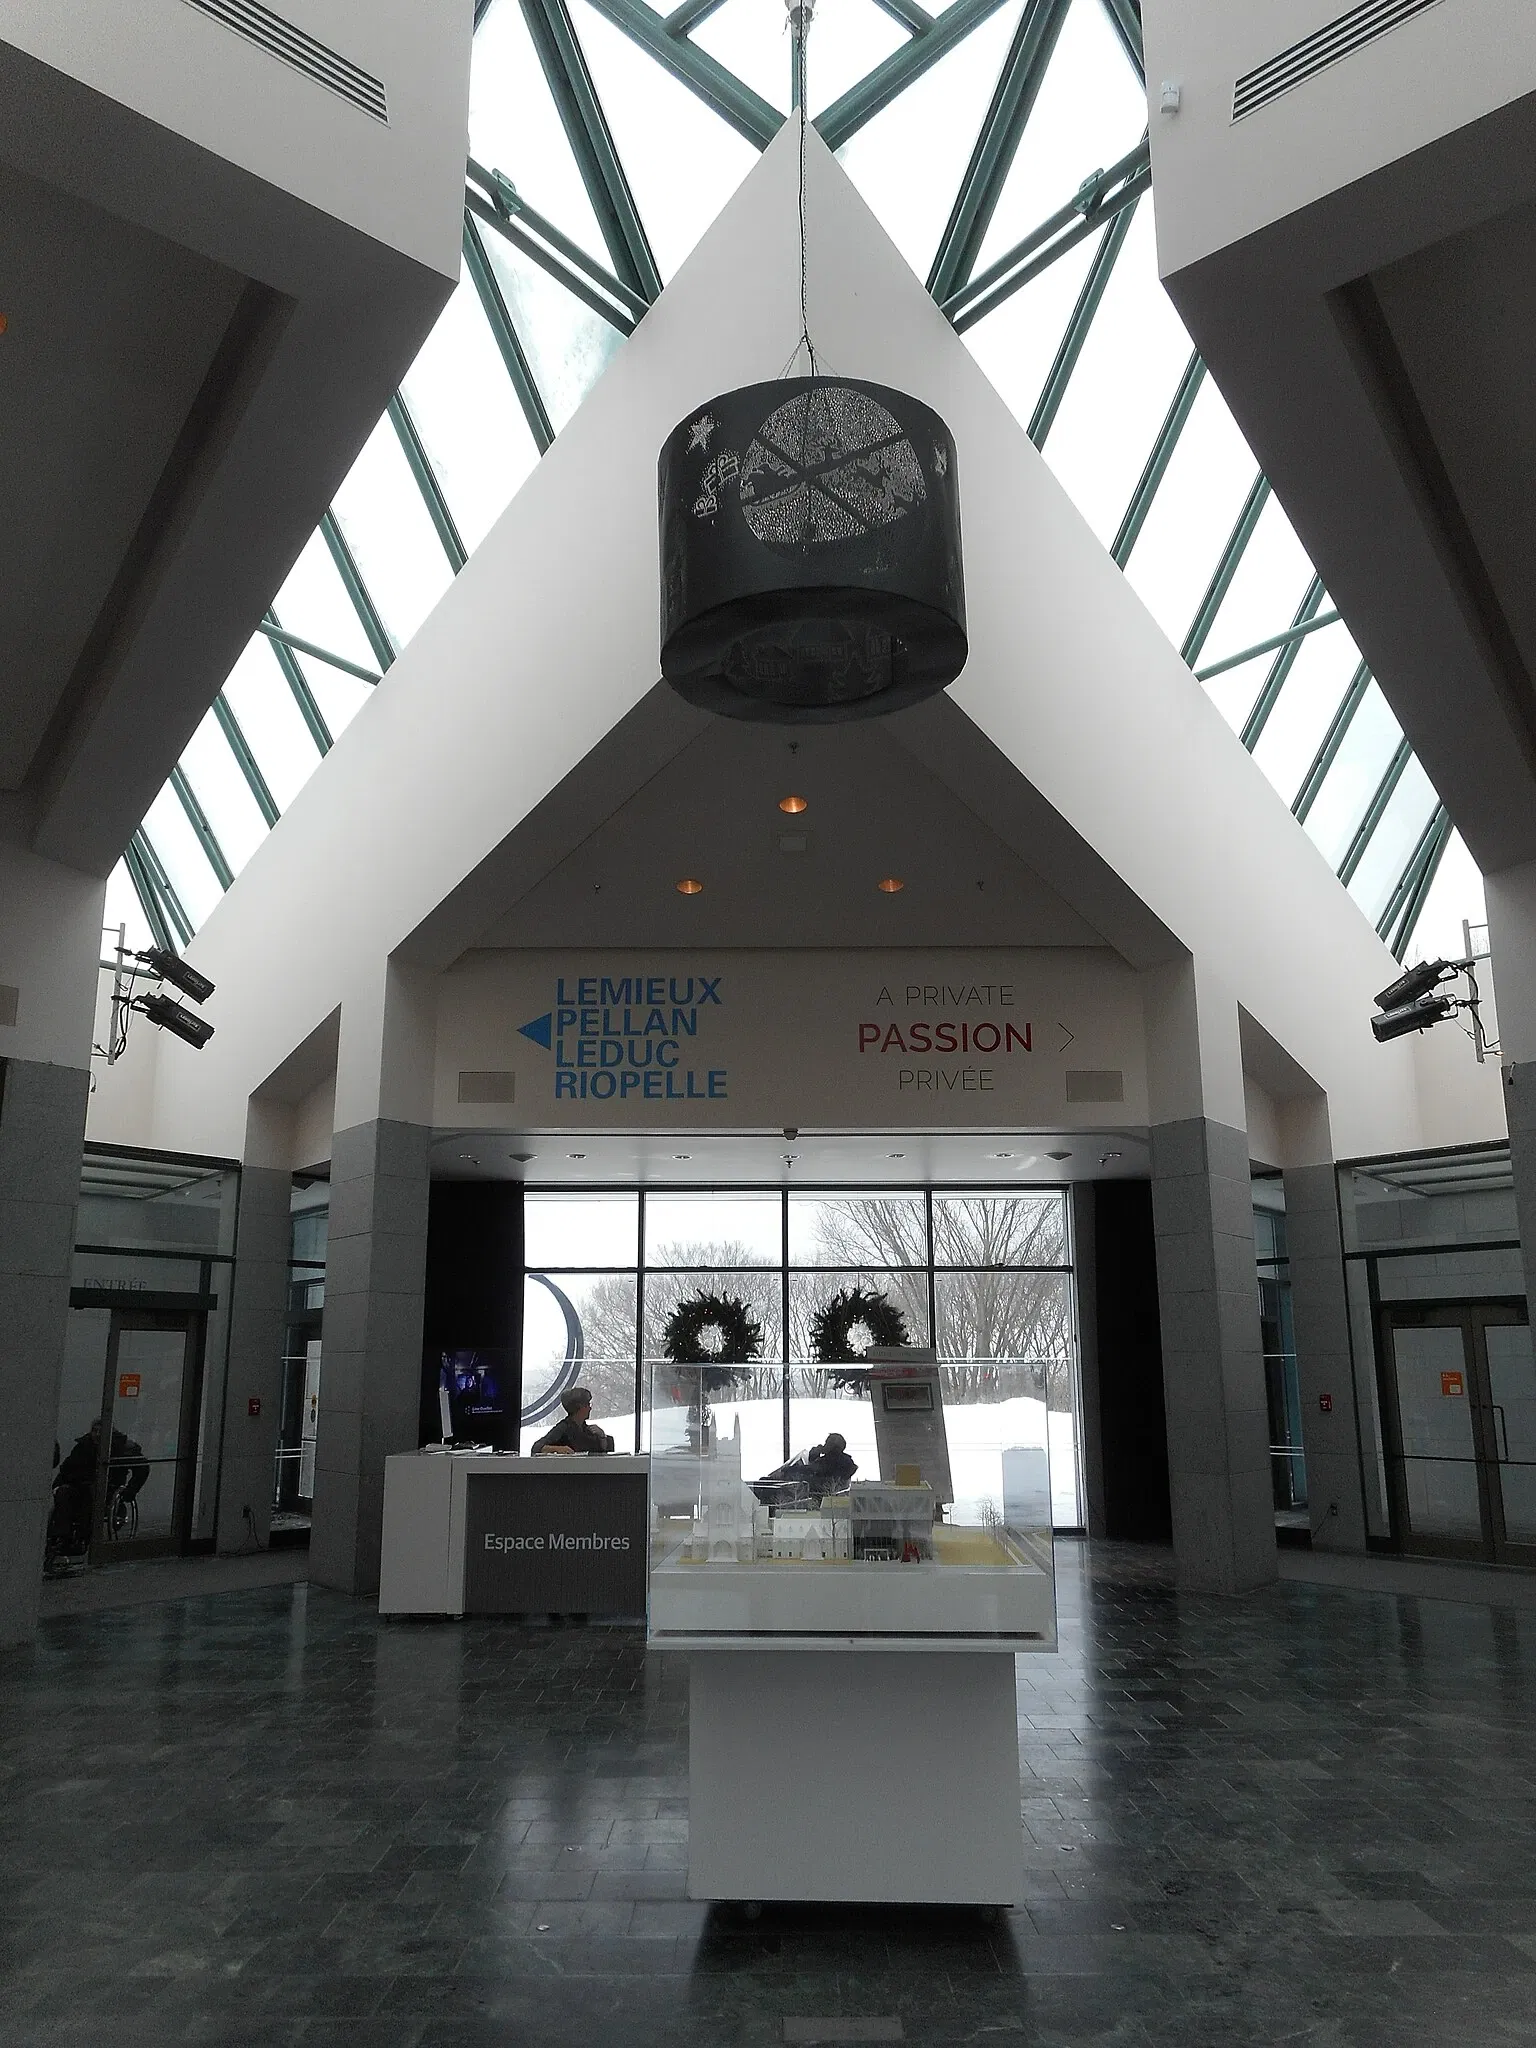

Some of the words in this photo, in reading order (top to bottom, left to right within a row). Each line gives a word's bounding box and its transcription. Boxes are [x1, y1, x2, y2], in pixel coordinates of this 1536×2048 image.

[557, 977, 723, 1006] LEMIEUX
[876, 986, 894, 1006] A
[905, 985, 1015, 1006] PRIVATE
[556, 1008, 697, 1037] PELLAN
[858, 1022, 1033, 1053] PASSION
[556, 1039, 680, 1068] LEDUC
[555, 1070, 728, 1099] RIOPELLE
[899, 1065, 994, 1091] PRIVÉE
[484, 1533, 545, 1554] Espace
[549, 1532, 631, 1550] Membres
